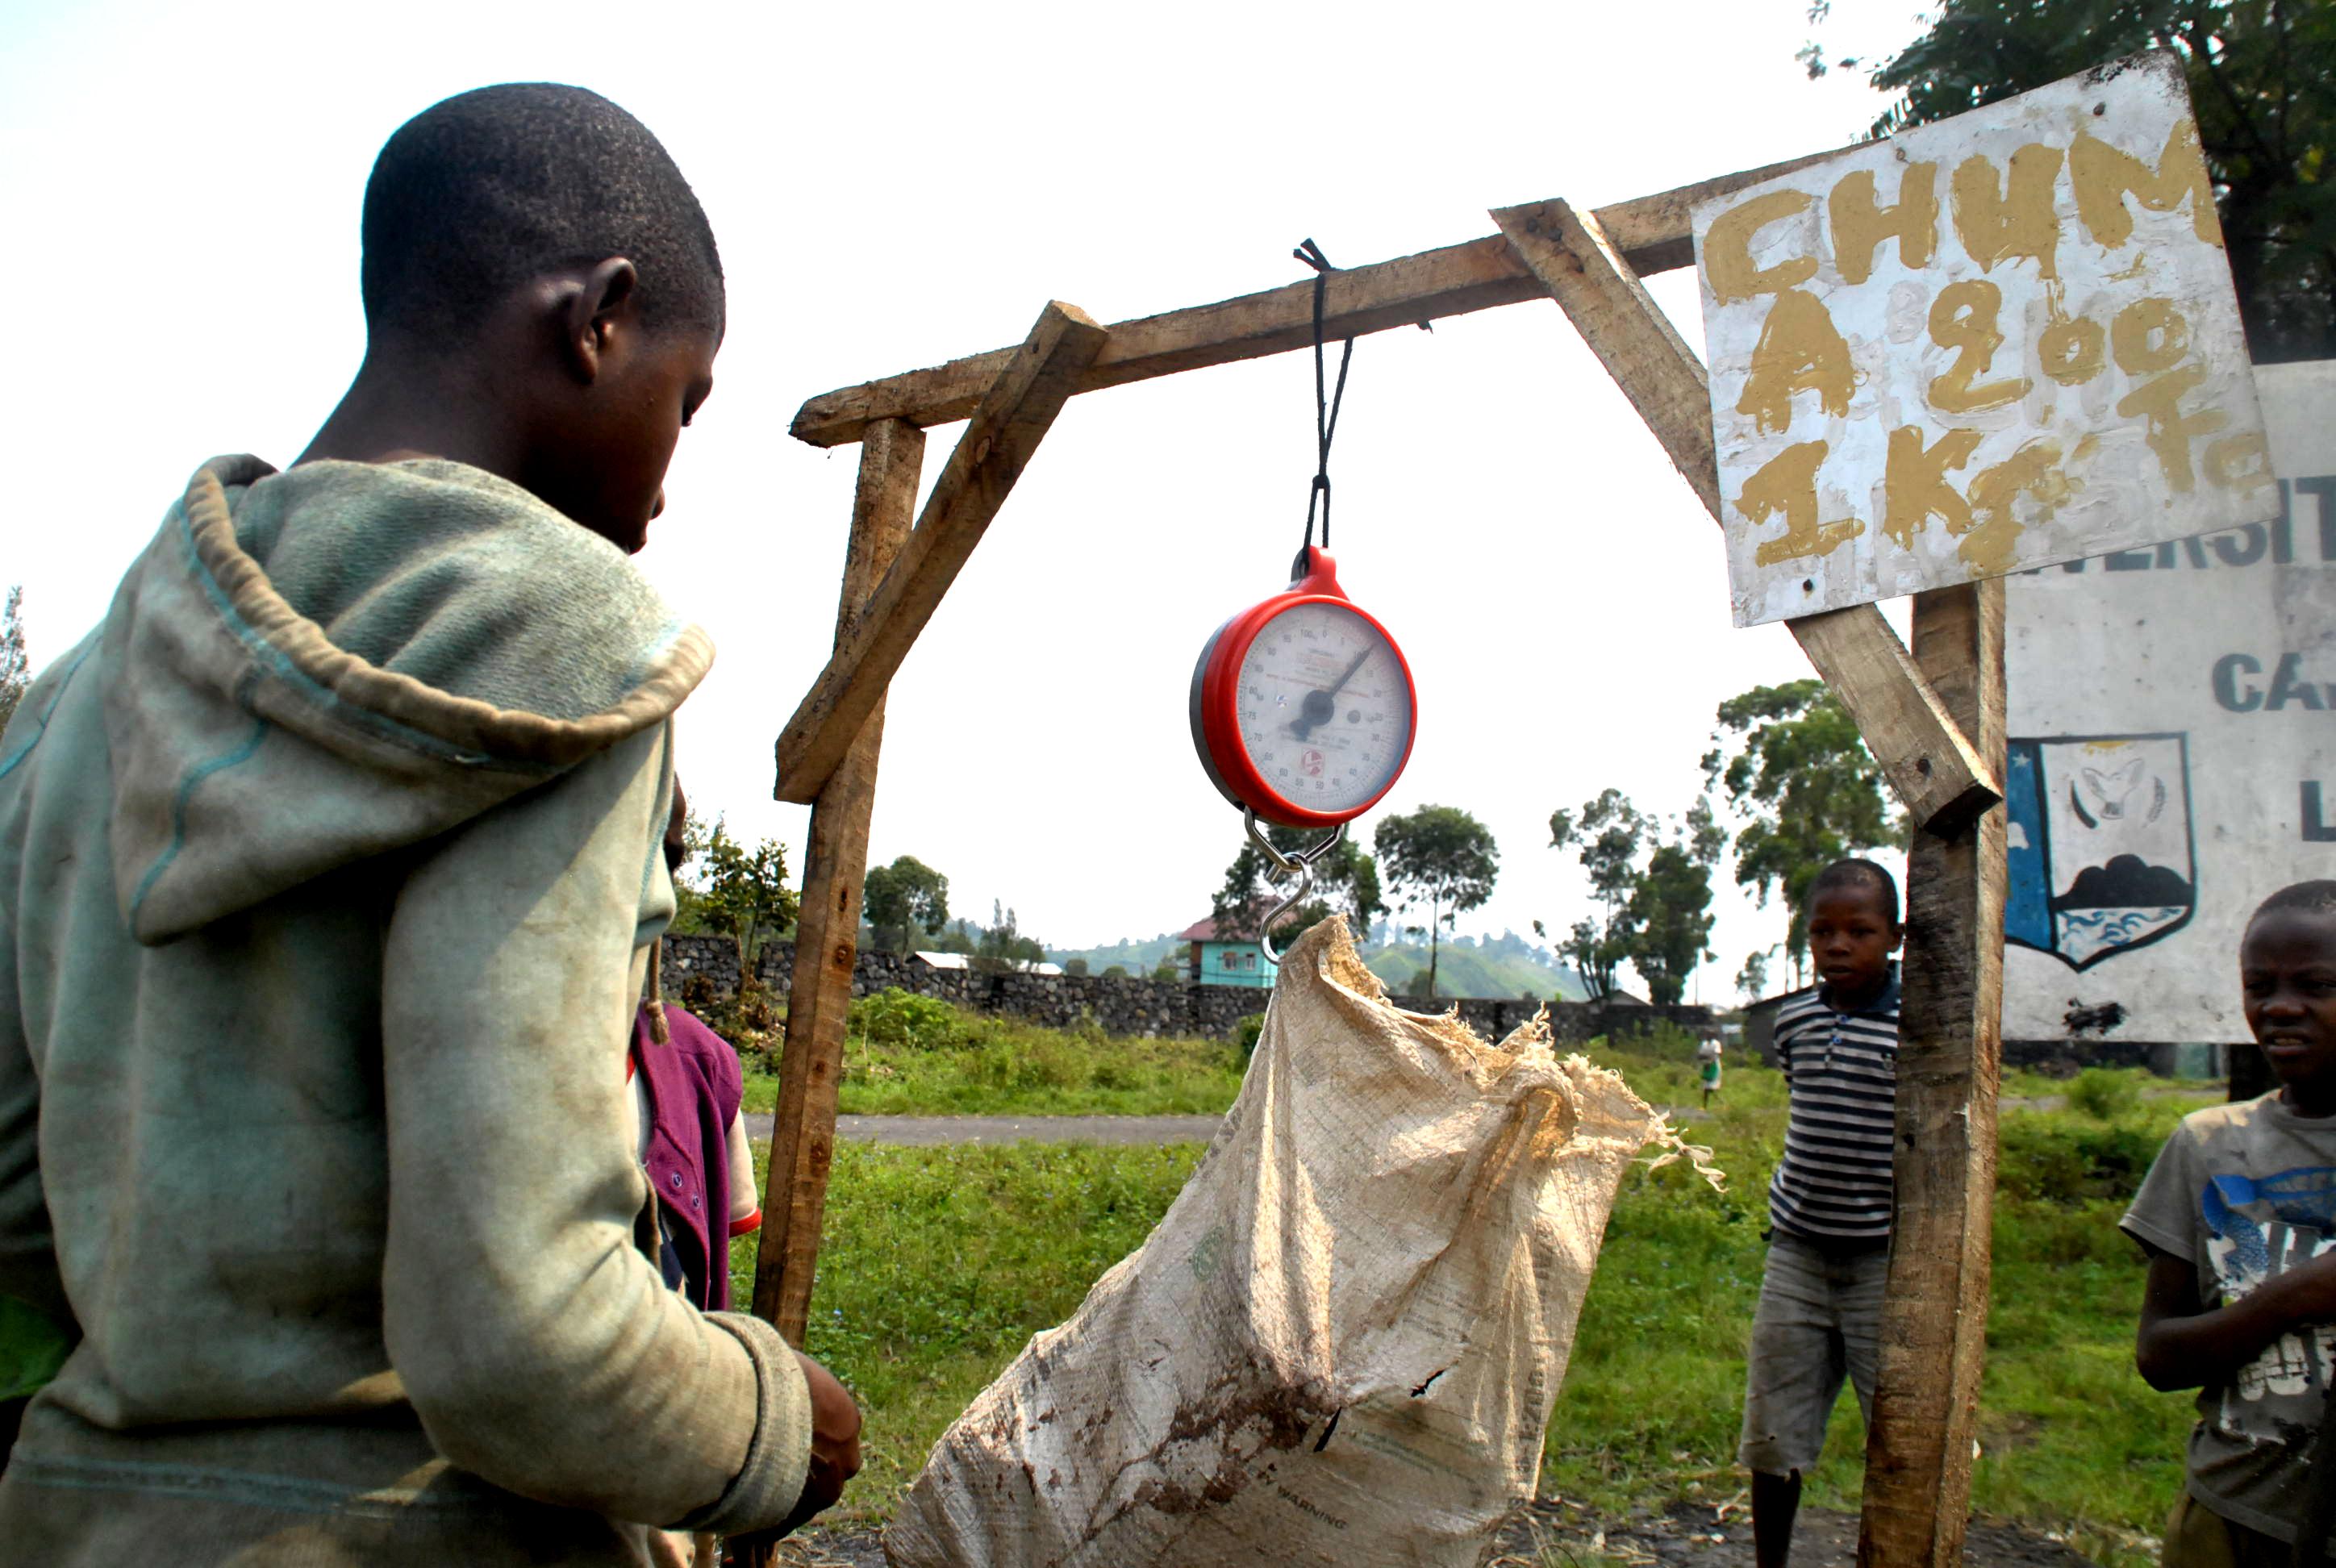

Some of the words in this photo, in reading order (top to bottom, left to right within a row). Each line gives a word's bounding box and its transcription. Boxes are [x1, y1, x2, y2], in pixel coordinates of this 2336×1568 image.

[1735, 288, 1860, 437] A
[1925, 278, 2190, 415] 200
[2212, 652, 2336, 713] CA
[1277, 1486, 1349, 1531] WARNING
